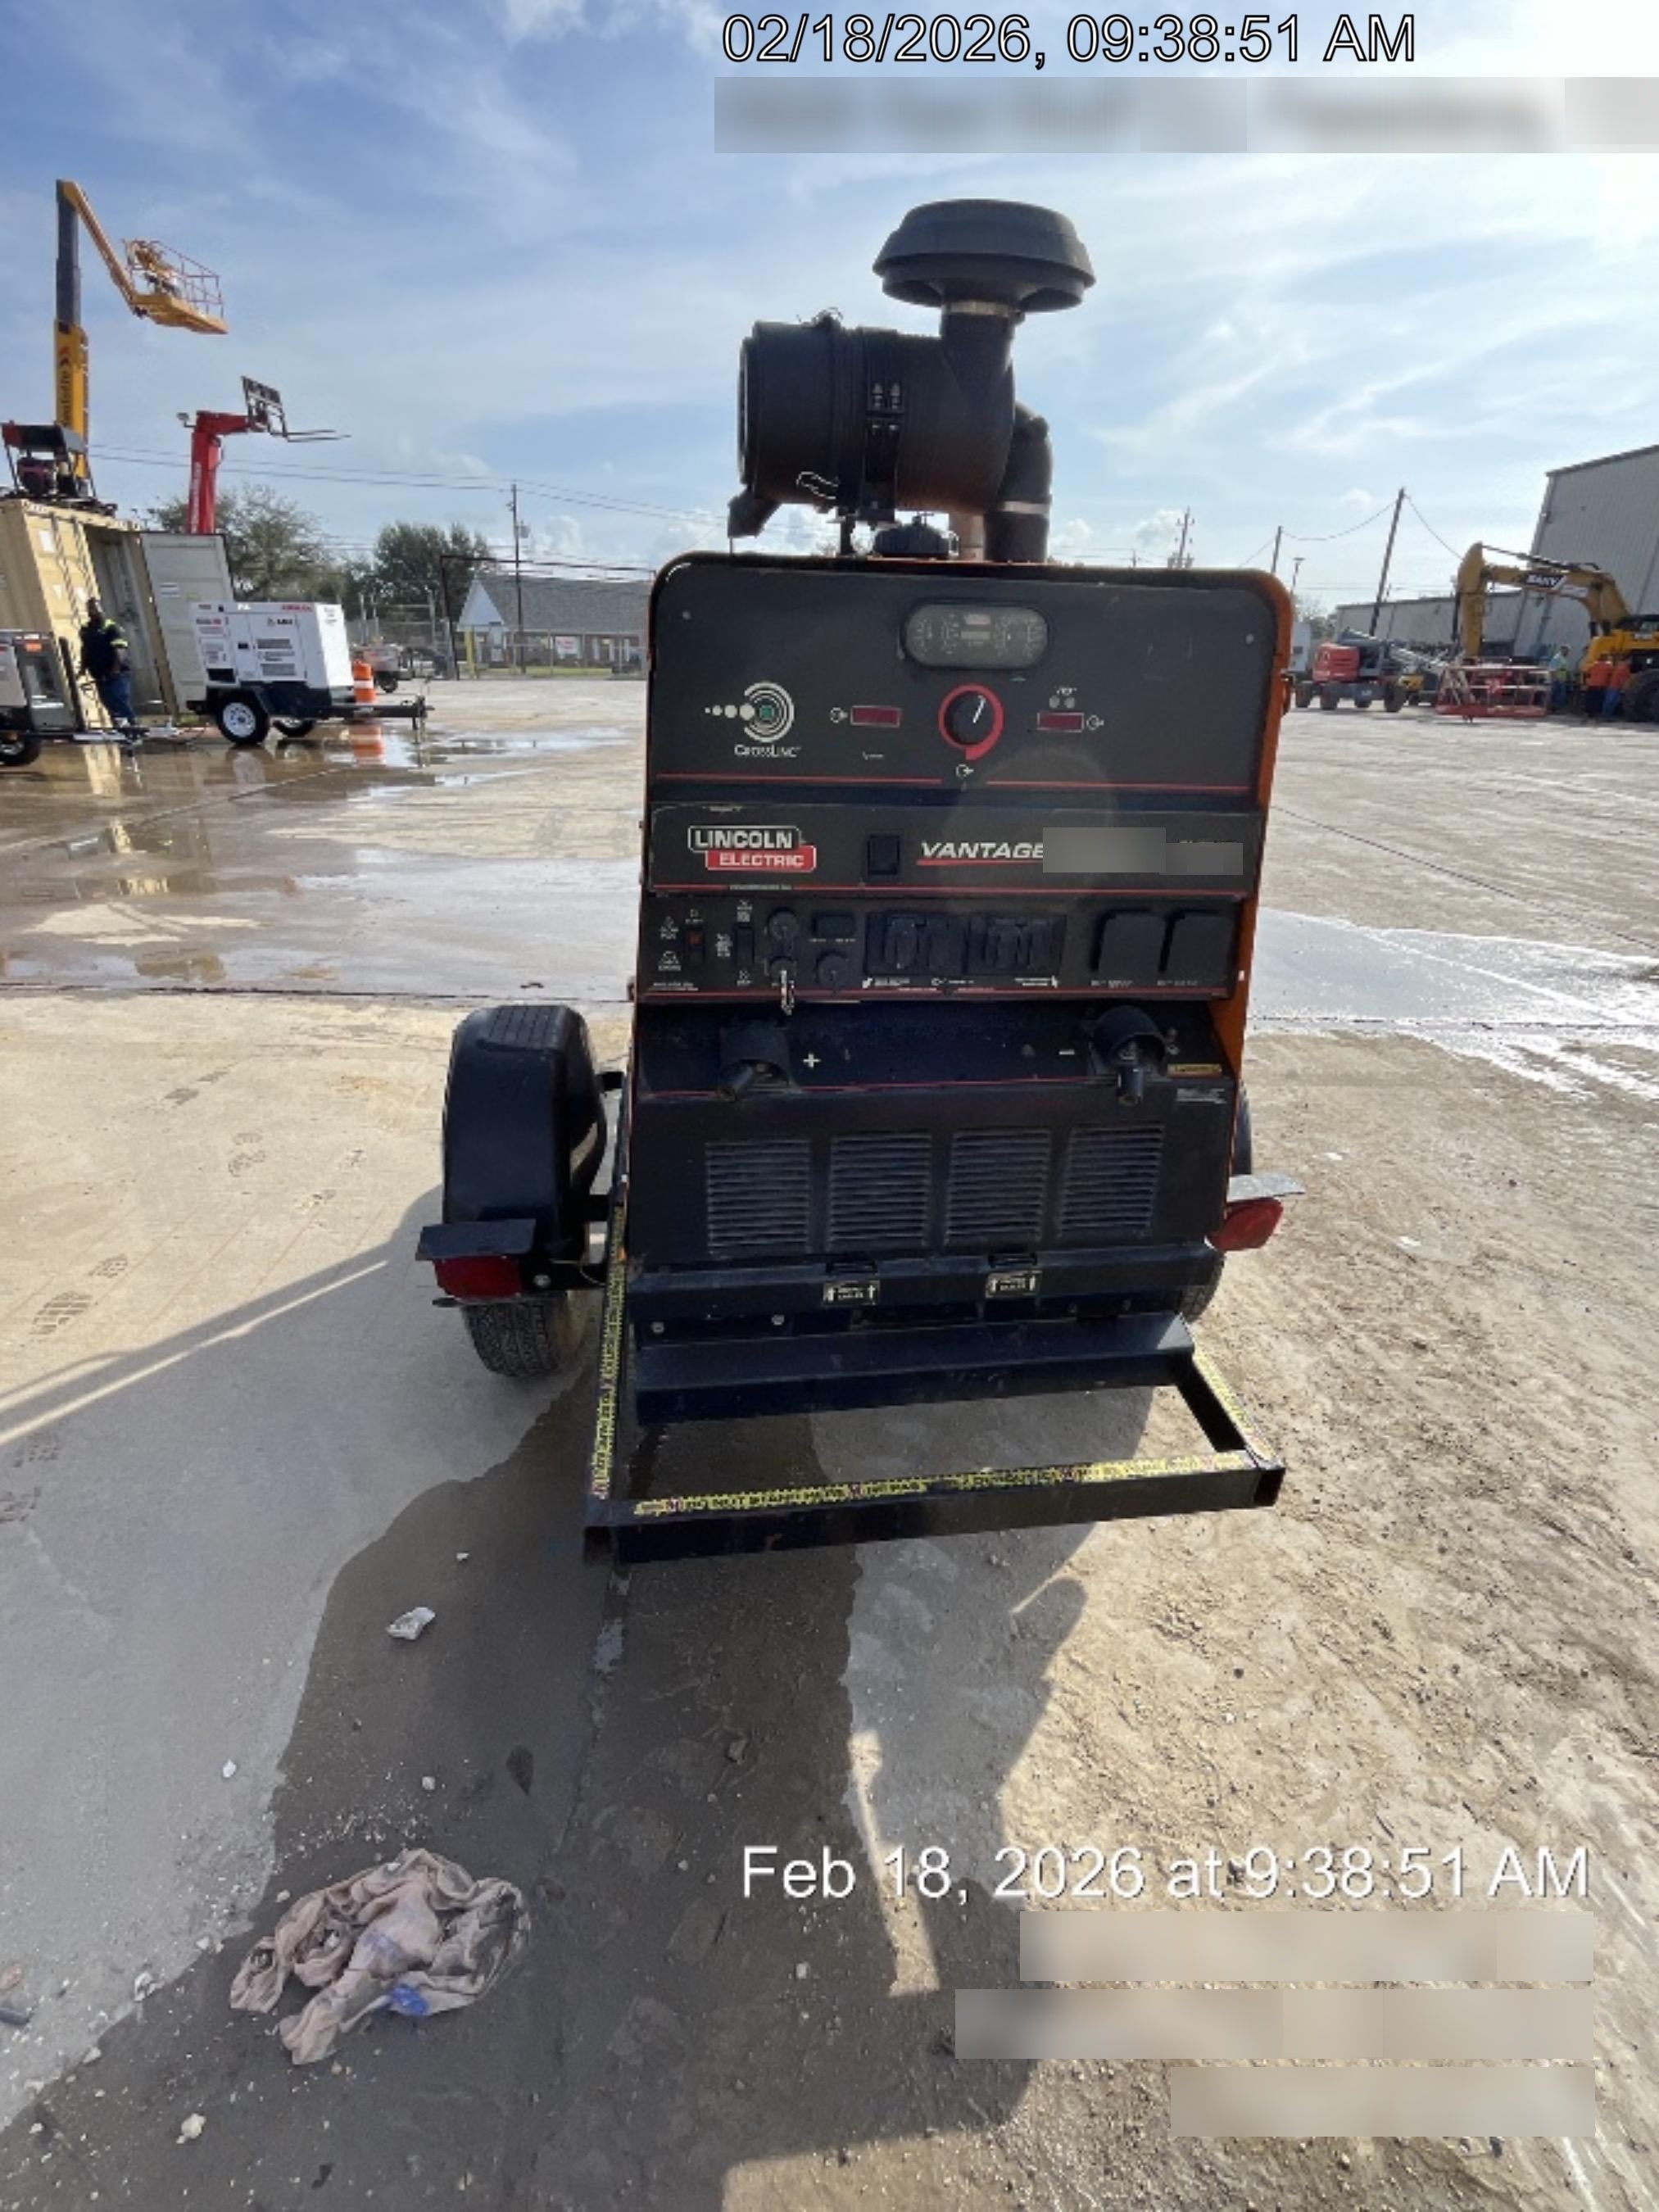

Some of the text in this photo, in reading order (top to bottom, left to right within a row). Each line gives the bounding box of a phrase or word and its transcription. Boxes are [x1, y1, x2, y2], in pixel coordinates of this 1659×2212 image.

[695, 829, 793, 850] LINCOLN
[921, 841, 1044, 859] VANTAGE
[718, 852, 805, 868] ELECTRIC
